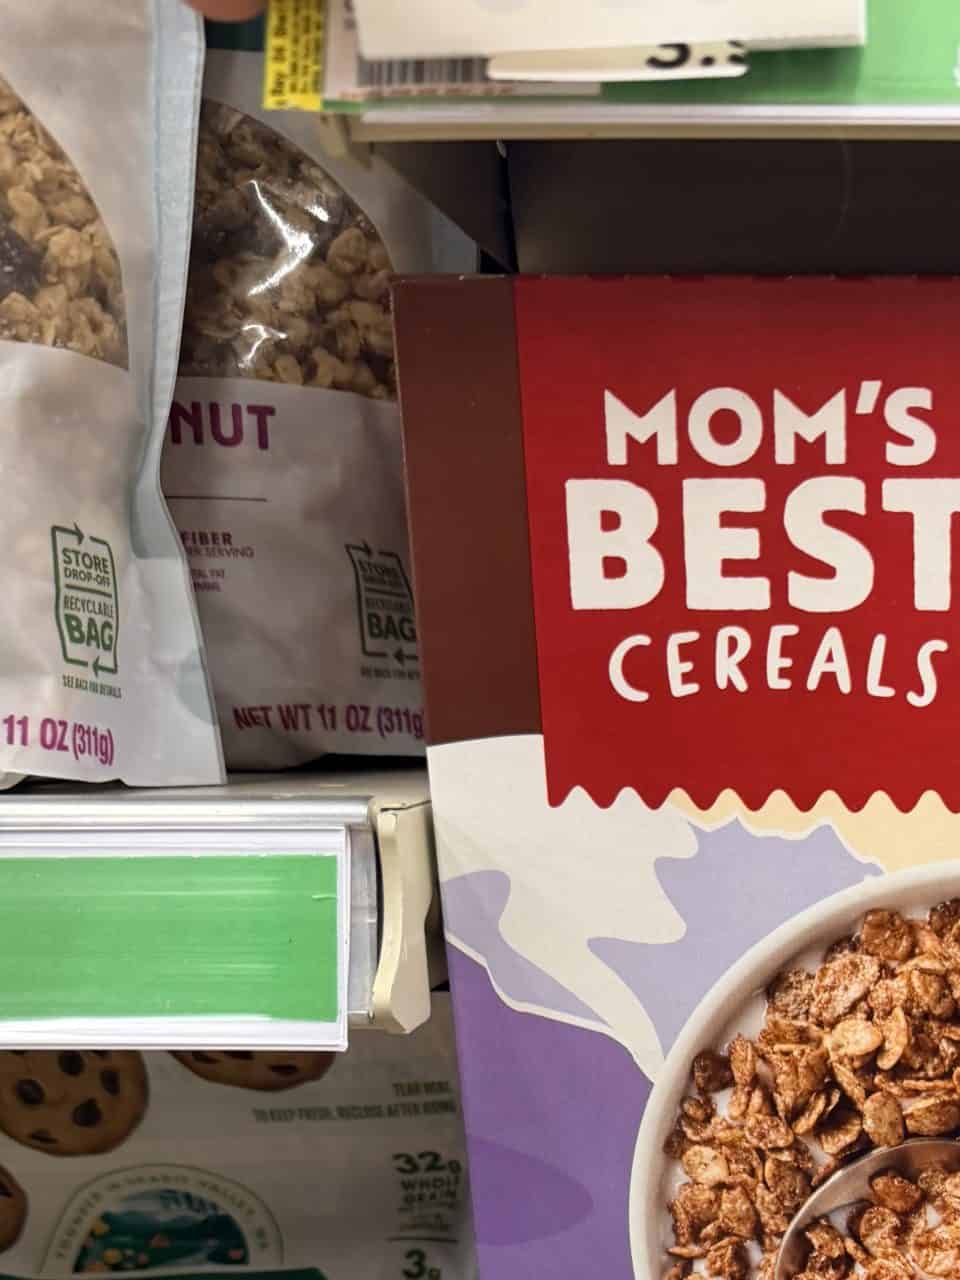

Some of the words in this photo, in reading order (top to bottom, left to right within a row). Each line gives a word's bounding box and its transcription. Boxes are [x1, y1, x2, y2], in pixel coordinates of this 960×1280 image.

[604, 381, 937, 466] MOM'S
[62, 548, 109, 575] STORE
[65, 613, 113, 652] BAG
[368, 612, 416, 642] BAG
[608, 625, 949, 708] CEREALS
[233, 705, 272, 731] NET
[277, 704, 312, 731] WT
[345, 705, 373, 731] OZ
[40, 717, 69, 752] OZ
[72, 721, 115, 766] (311g)
